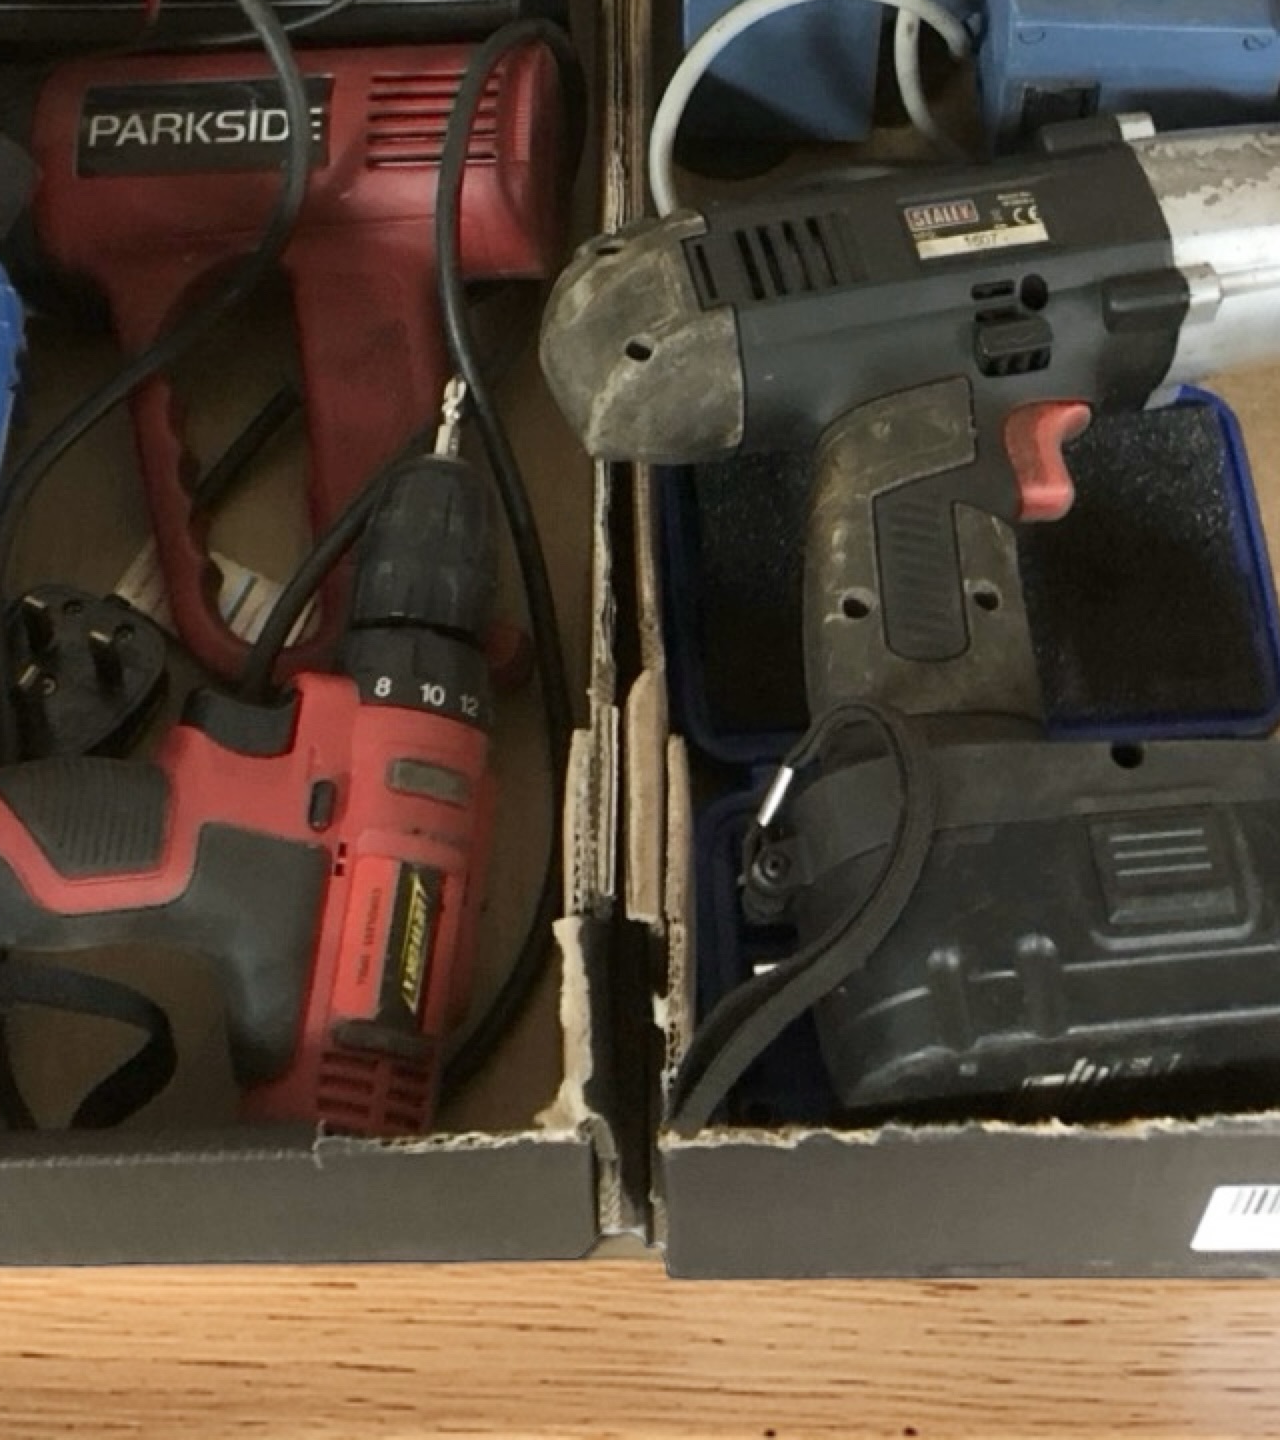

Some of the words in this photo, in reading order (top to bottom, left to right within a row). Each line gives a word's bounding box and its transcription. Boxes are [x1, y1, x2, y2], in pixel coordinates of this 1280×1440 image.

[374, 676, 393, 698] 8
[419, 682, 447, 707] 10
[459, 694, 479, 718] 12
